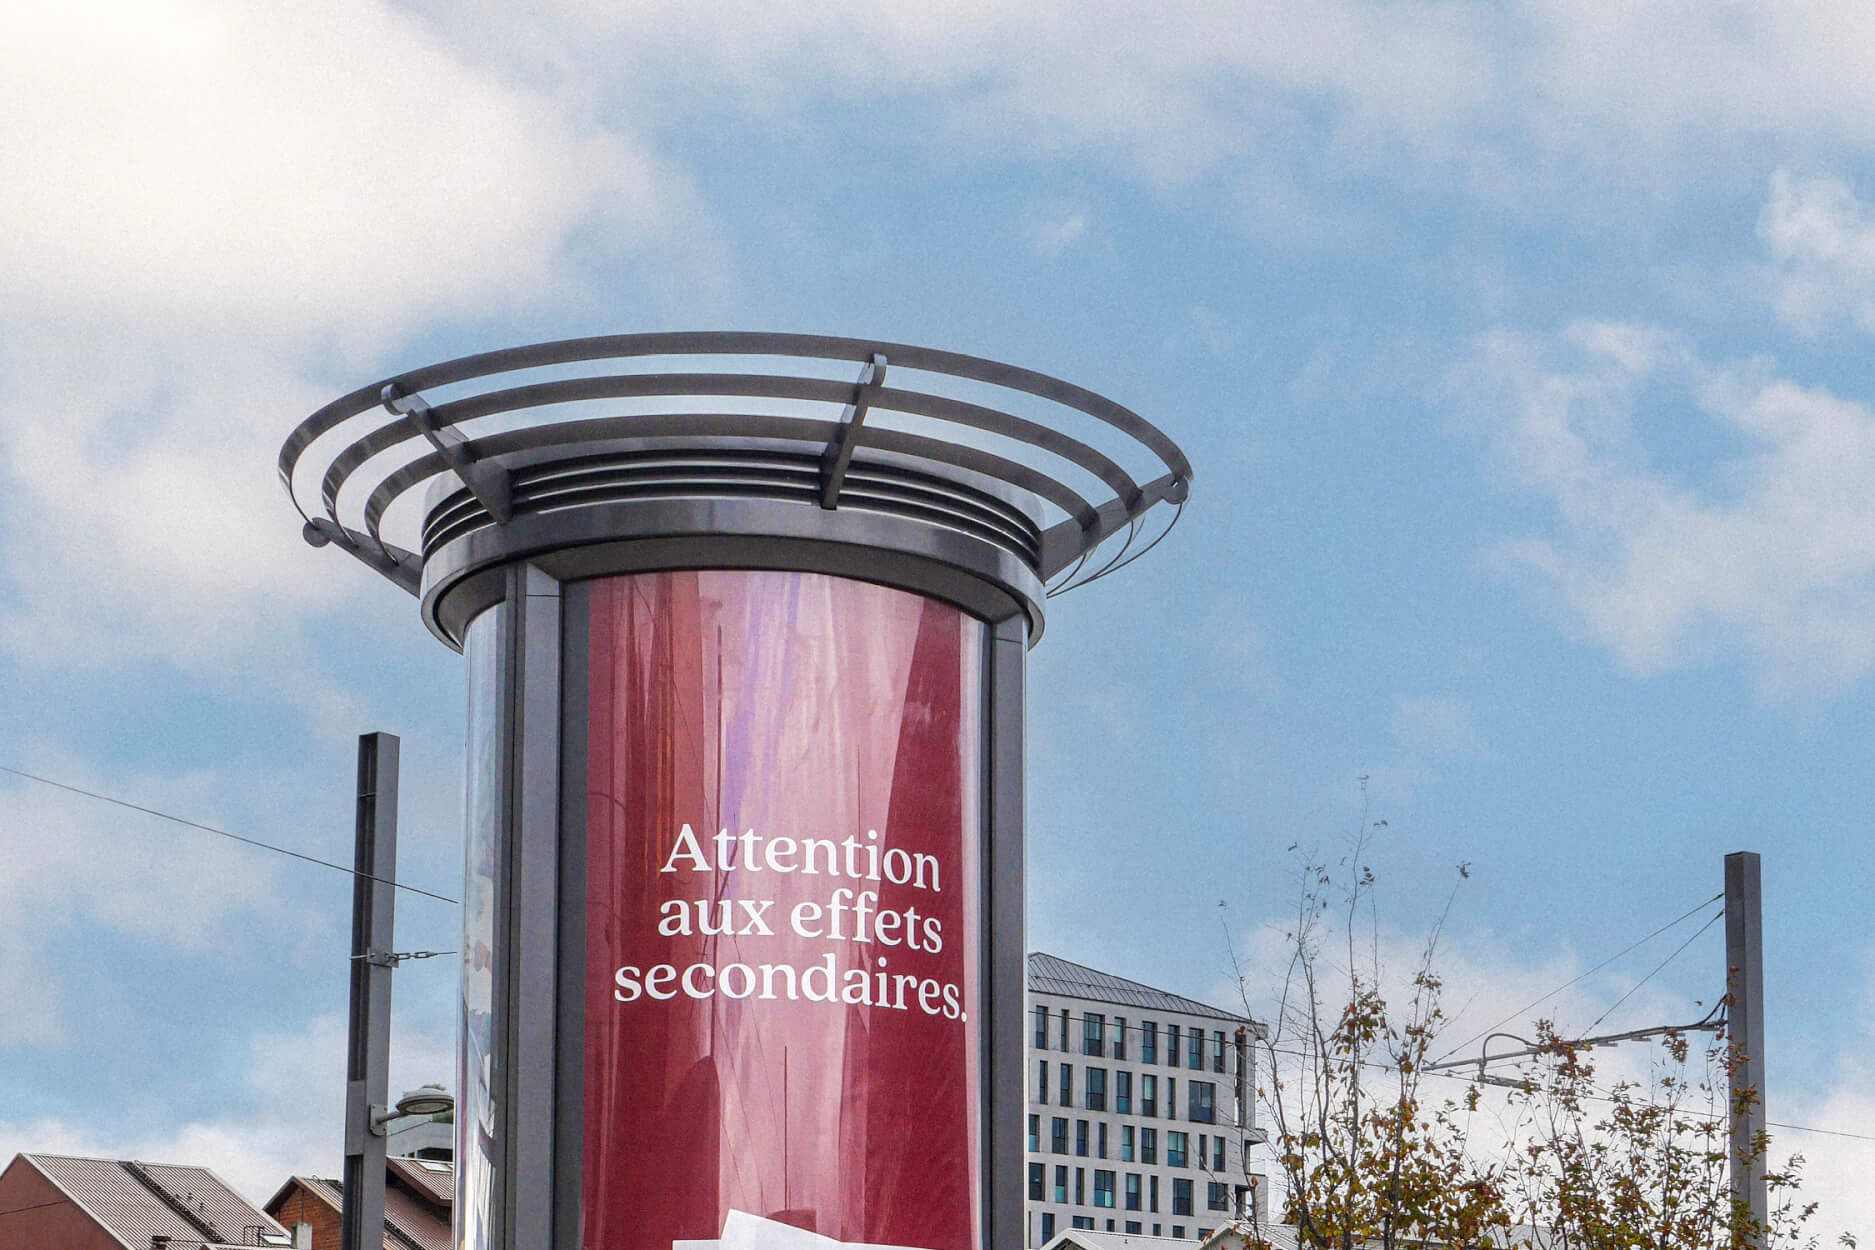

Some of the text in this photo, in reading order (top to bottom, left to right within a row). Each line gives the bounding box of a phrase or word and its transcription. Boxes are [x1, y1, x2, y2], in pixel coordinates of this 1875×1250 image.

[660, 823, 941, 892] Attention
[658, 888, 944, 954] aux effets
[614, 952, 968, 1023] secondaires.
